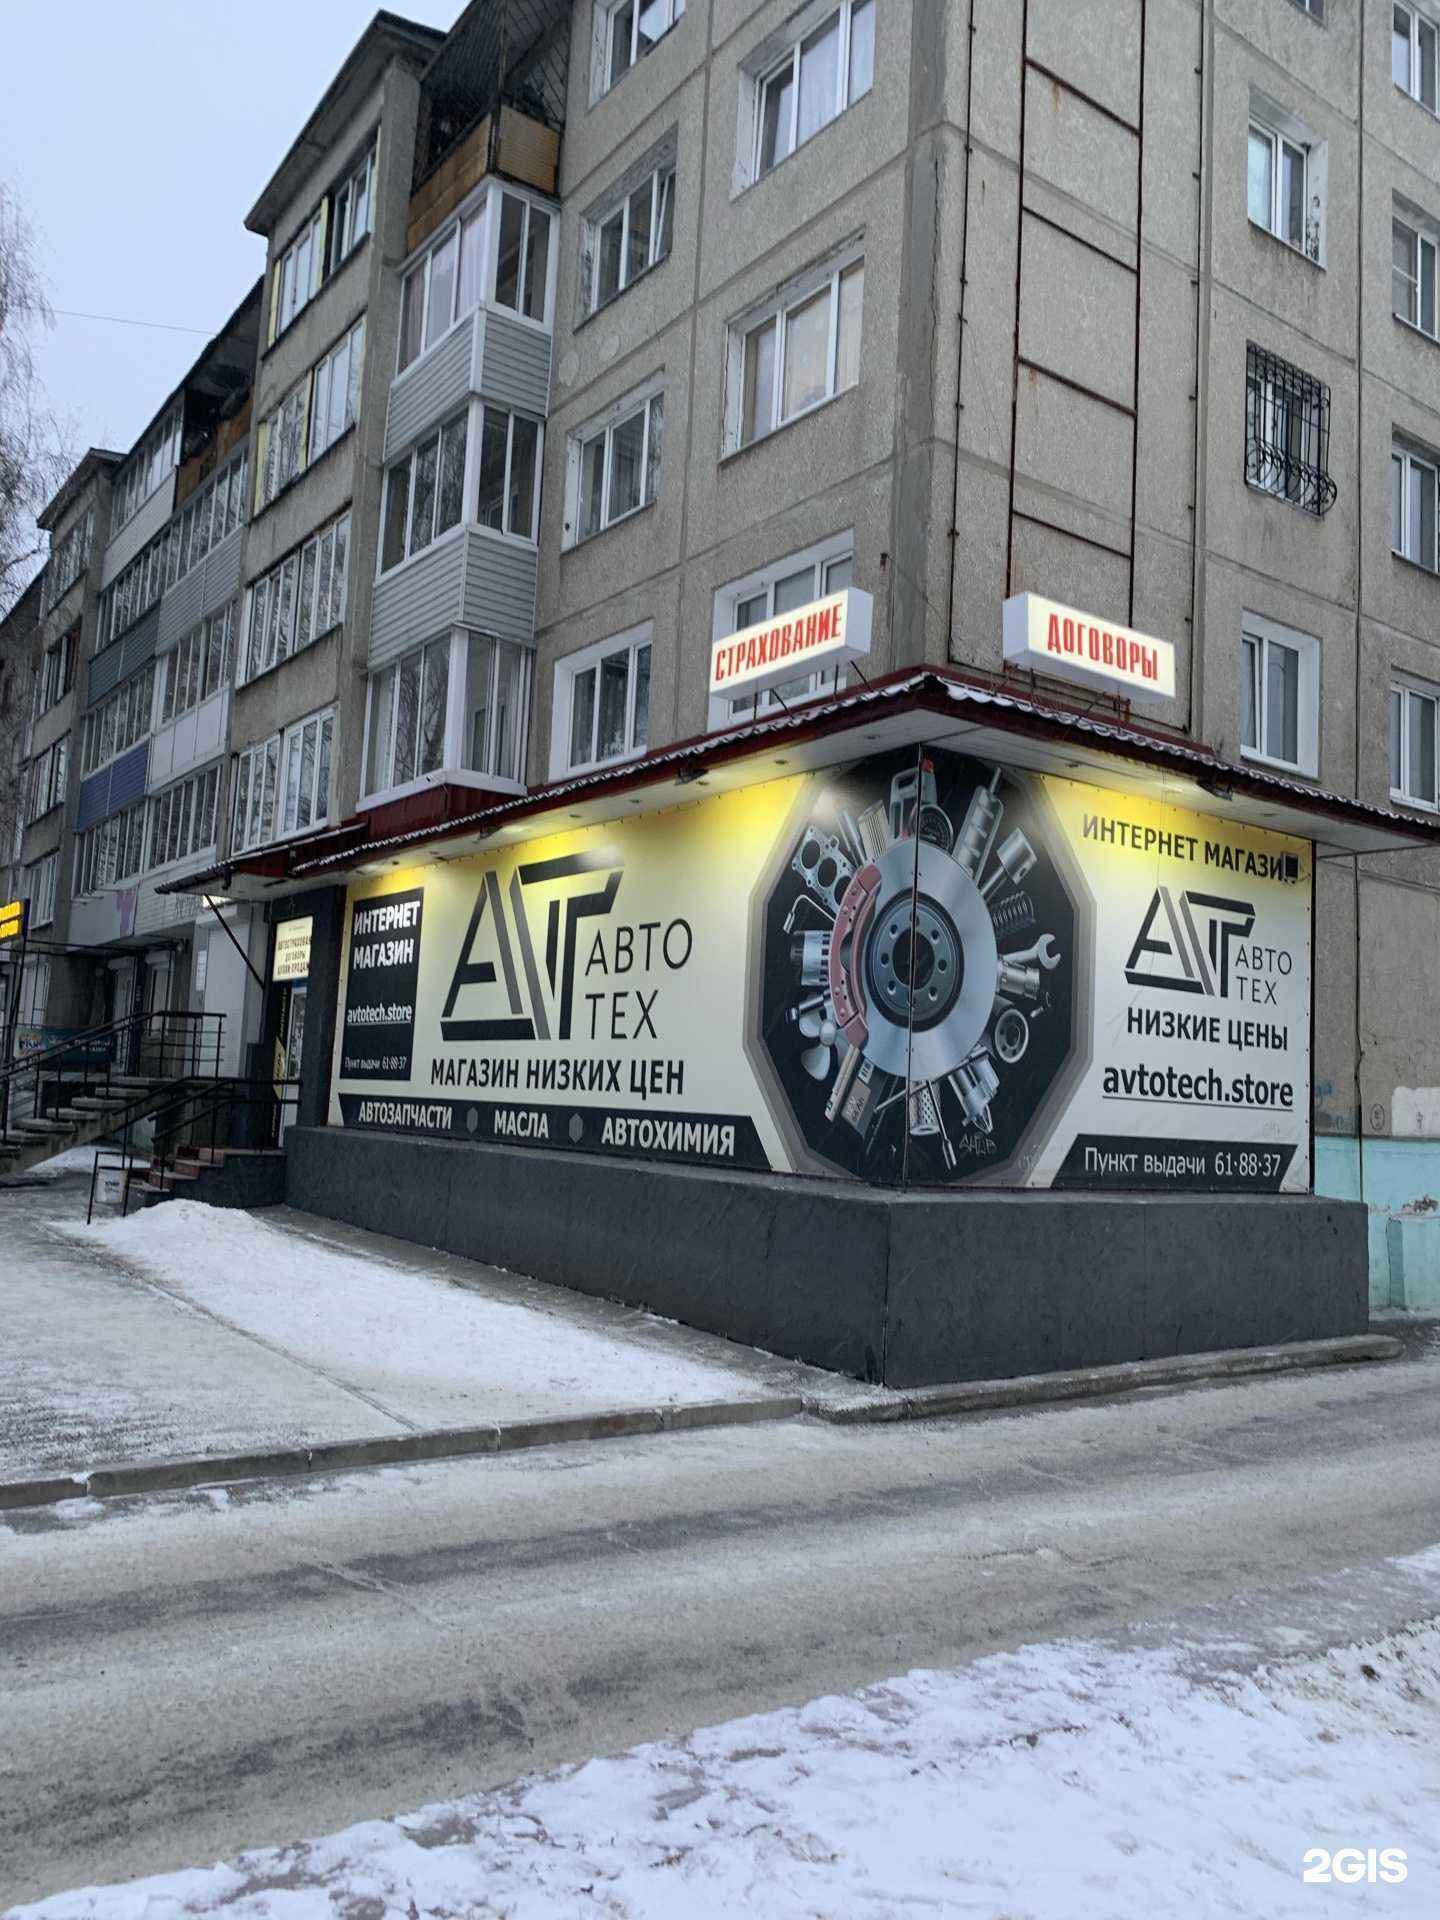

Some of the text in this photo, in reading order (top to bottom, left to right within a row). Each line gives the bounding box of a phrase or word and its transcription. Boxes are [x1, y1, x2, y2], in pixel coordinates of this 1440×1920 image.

[714, 602, 843, 682] СТРАХОВАНИЕ
[1047, 613, 1159, 681] ДОГОВОРЫ
[1082, 813, 1298, 884] ИНТЕРНЕТ МАГАЗИ
[354, 901, 420, 935] ИНТЕРНЕТ
[353, 938, 415, 970] МАГАЗИН
[585, 918, 692, 977] АВТО
[1235, 944, 1293, 975] АВТО
[1236, 976, 1278, 1006] ТЕХ
[347, 1003, 412, 1024] avtotech.store
[585, 990, 659, 1040] ТЕХ
[1127, 1007, 1288, 1051] НИЗКИЕ ЦЕНЫ
[431, 1058, 685, 1101] МАГАЗИН НИЗКИХ ЦЕН
[1103, 1064, 1293, 1107] avtotech.store
[358, 1101, 735, 1156] АВТОЗАПЧАСТИ МАСЛА АВТОХИМИЯ
[1084, 1147, 1138, 1176] Пункт
[1144, 1155, 1206, 1180] выдачи
